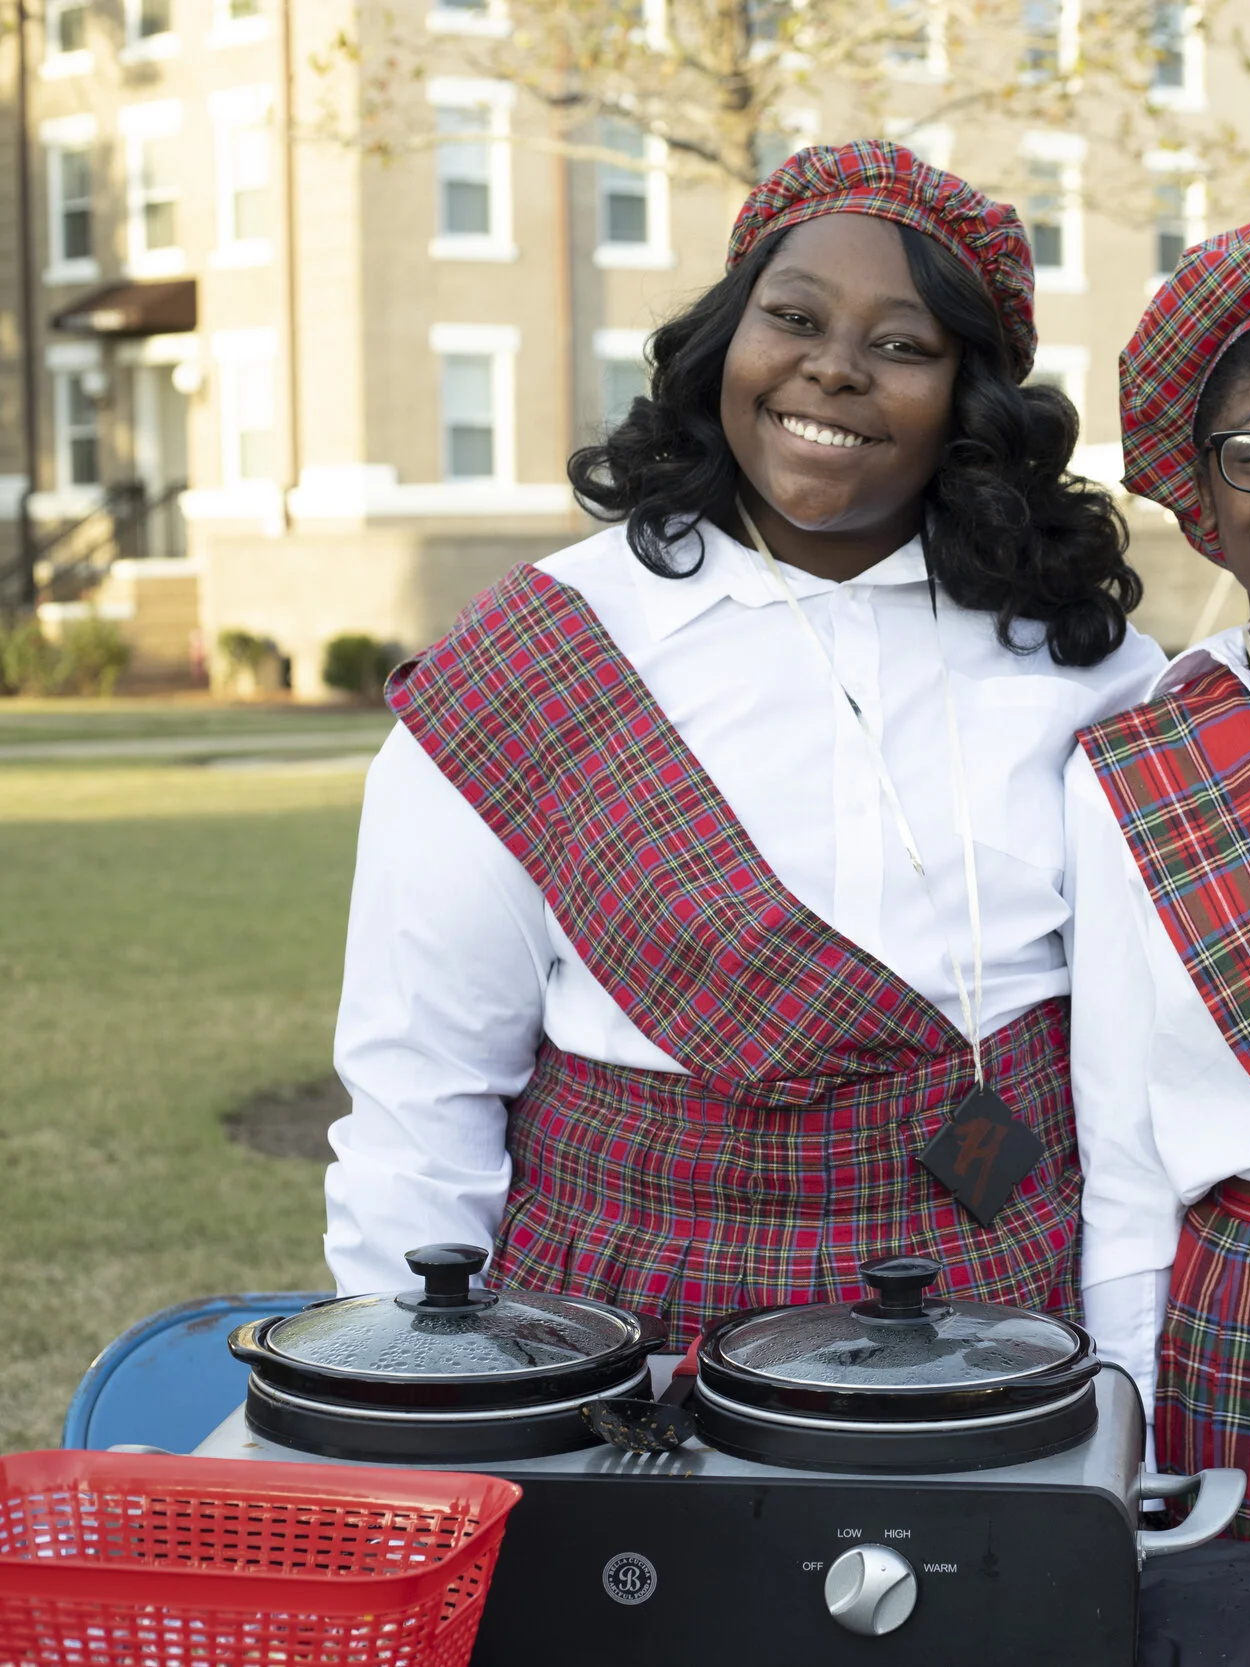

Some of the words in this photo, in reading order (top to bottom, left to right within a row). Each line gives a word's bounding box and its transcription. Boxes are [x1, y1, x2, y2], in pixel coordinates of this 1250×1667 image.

[837, 1528, 862, 1538] LOW
[884, 1529, 911, 1539] HIGH
[609, 1558, 628, 1576] BELLA
[628, 1558, 651, 1578] CUCINA
[802, 1562, 824, 1571] OFF
[923, 1563, 957, 1573] WARM
[609, 1582, 634, 1600] ARTFUL
[633, 1583, 650, 1599] FOOD
